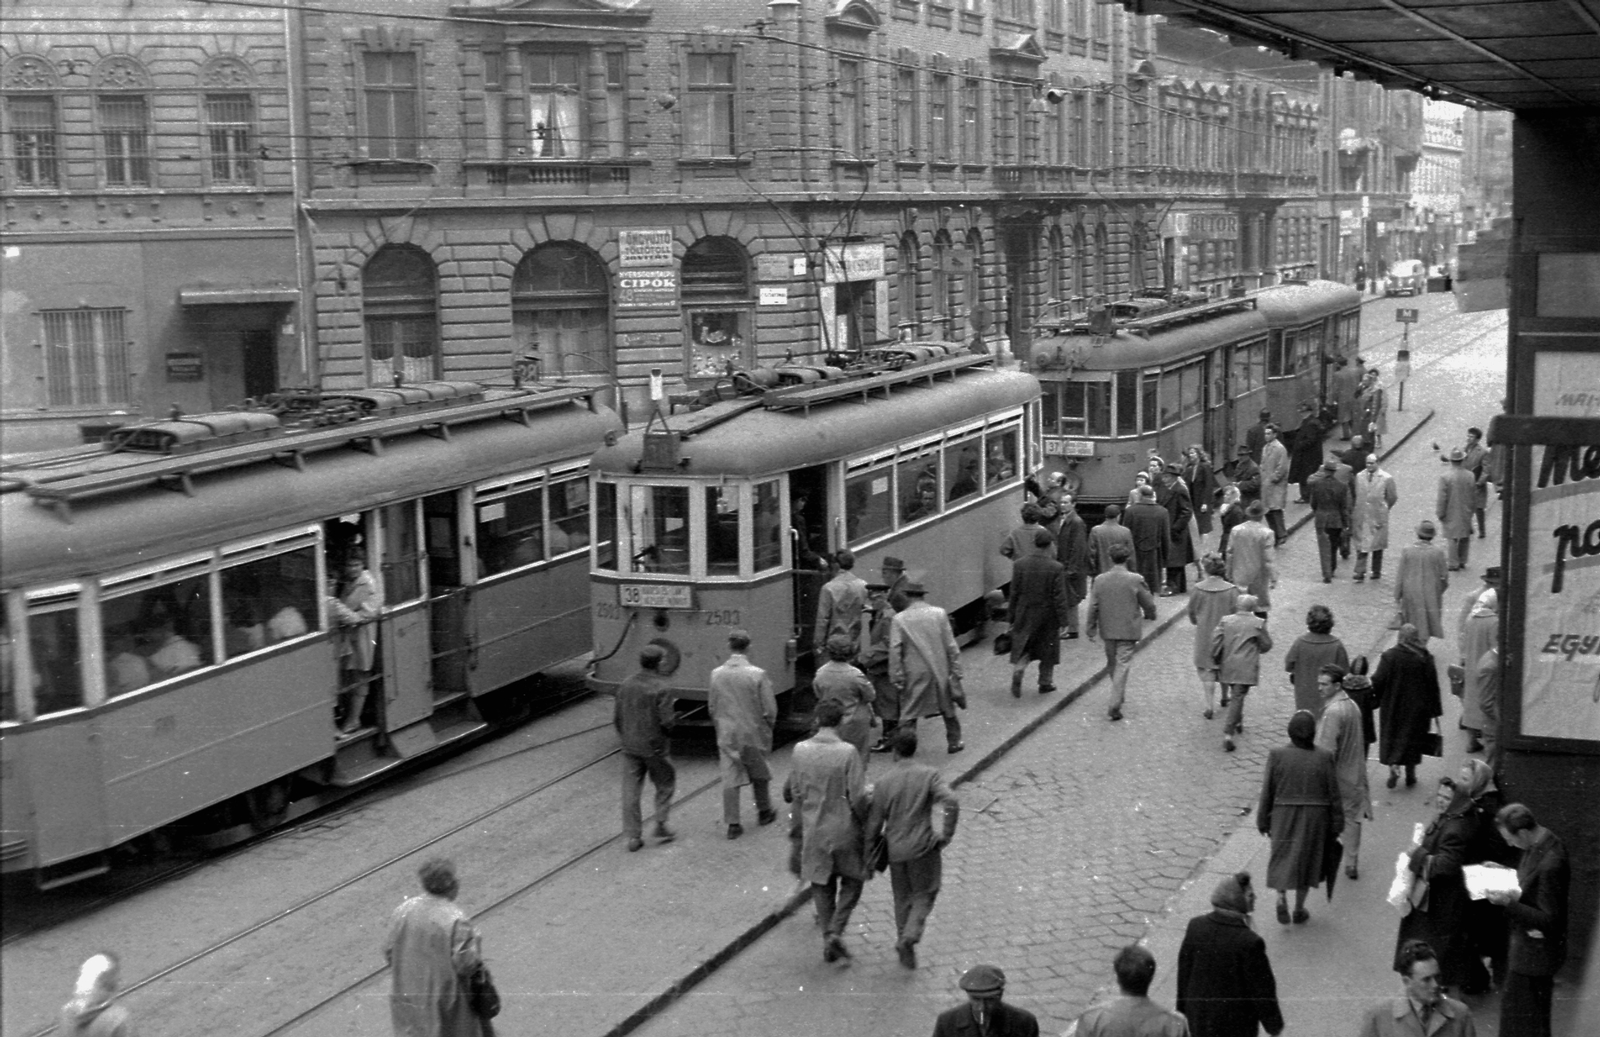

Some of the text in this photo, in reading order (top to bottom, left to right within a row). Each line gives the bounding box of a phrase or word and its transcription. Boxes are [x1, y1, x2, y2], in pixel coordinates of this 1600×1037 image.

[619, 288, 634, 302] 48
[1402, 309, 1412, 317] M
[1048, 442, 1060, 452] 37
[624, 587, 640, 603] 38
[706, 610, 740, 626] 2503
[1541, 633, 1600, 662] EGY
